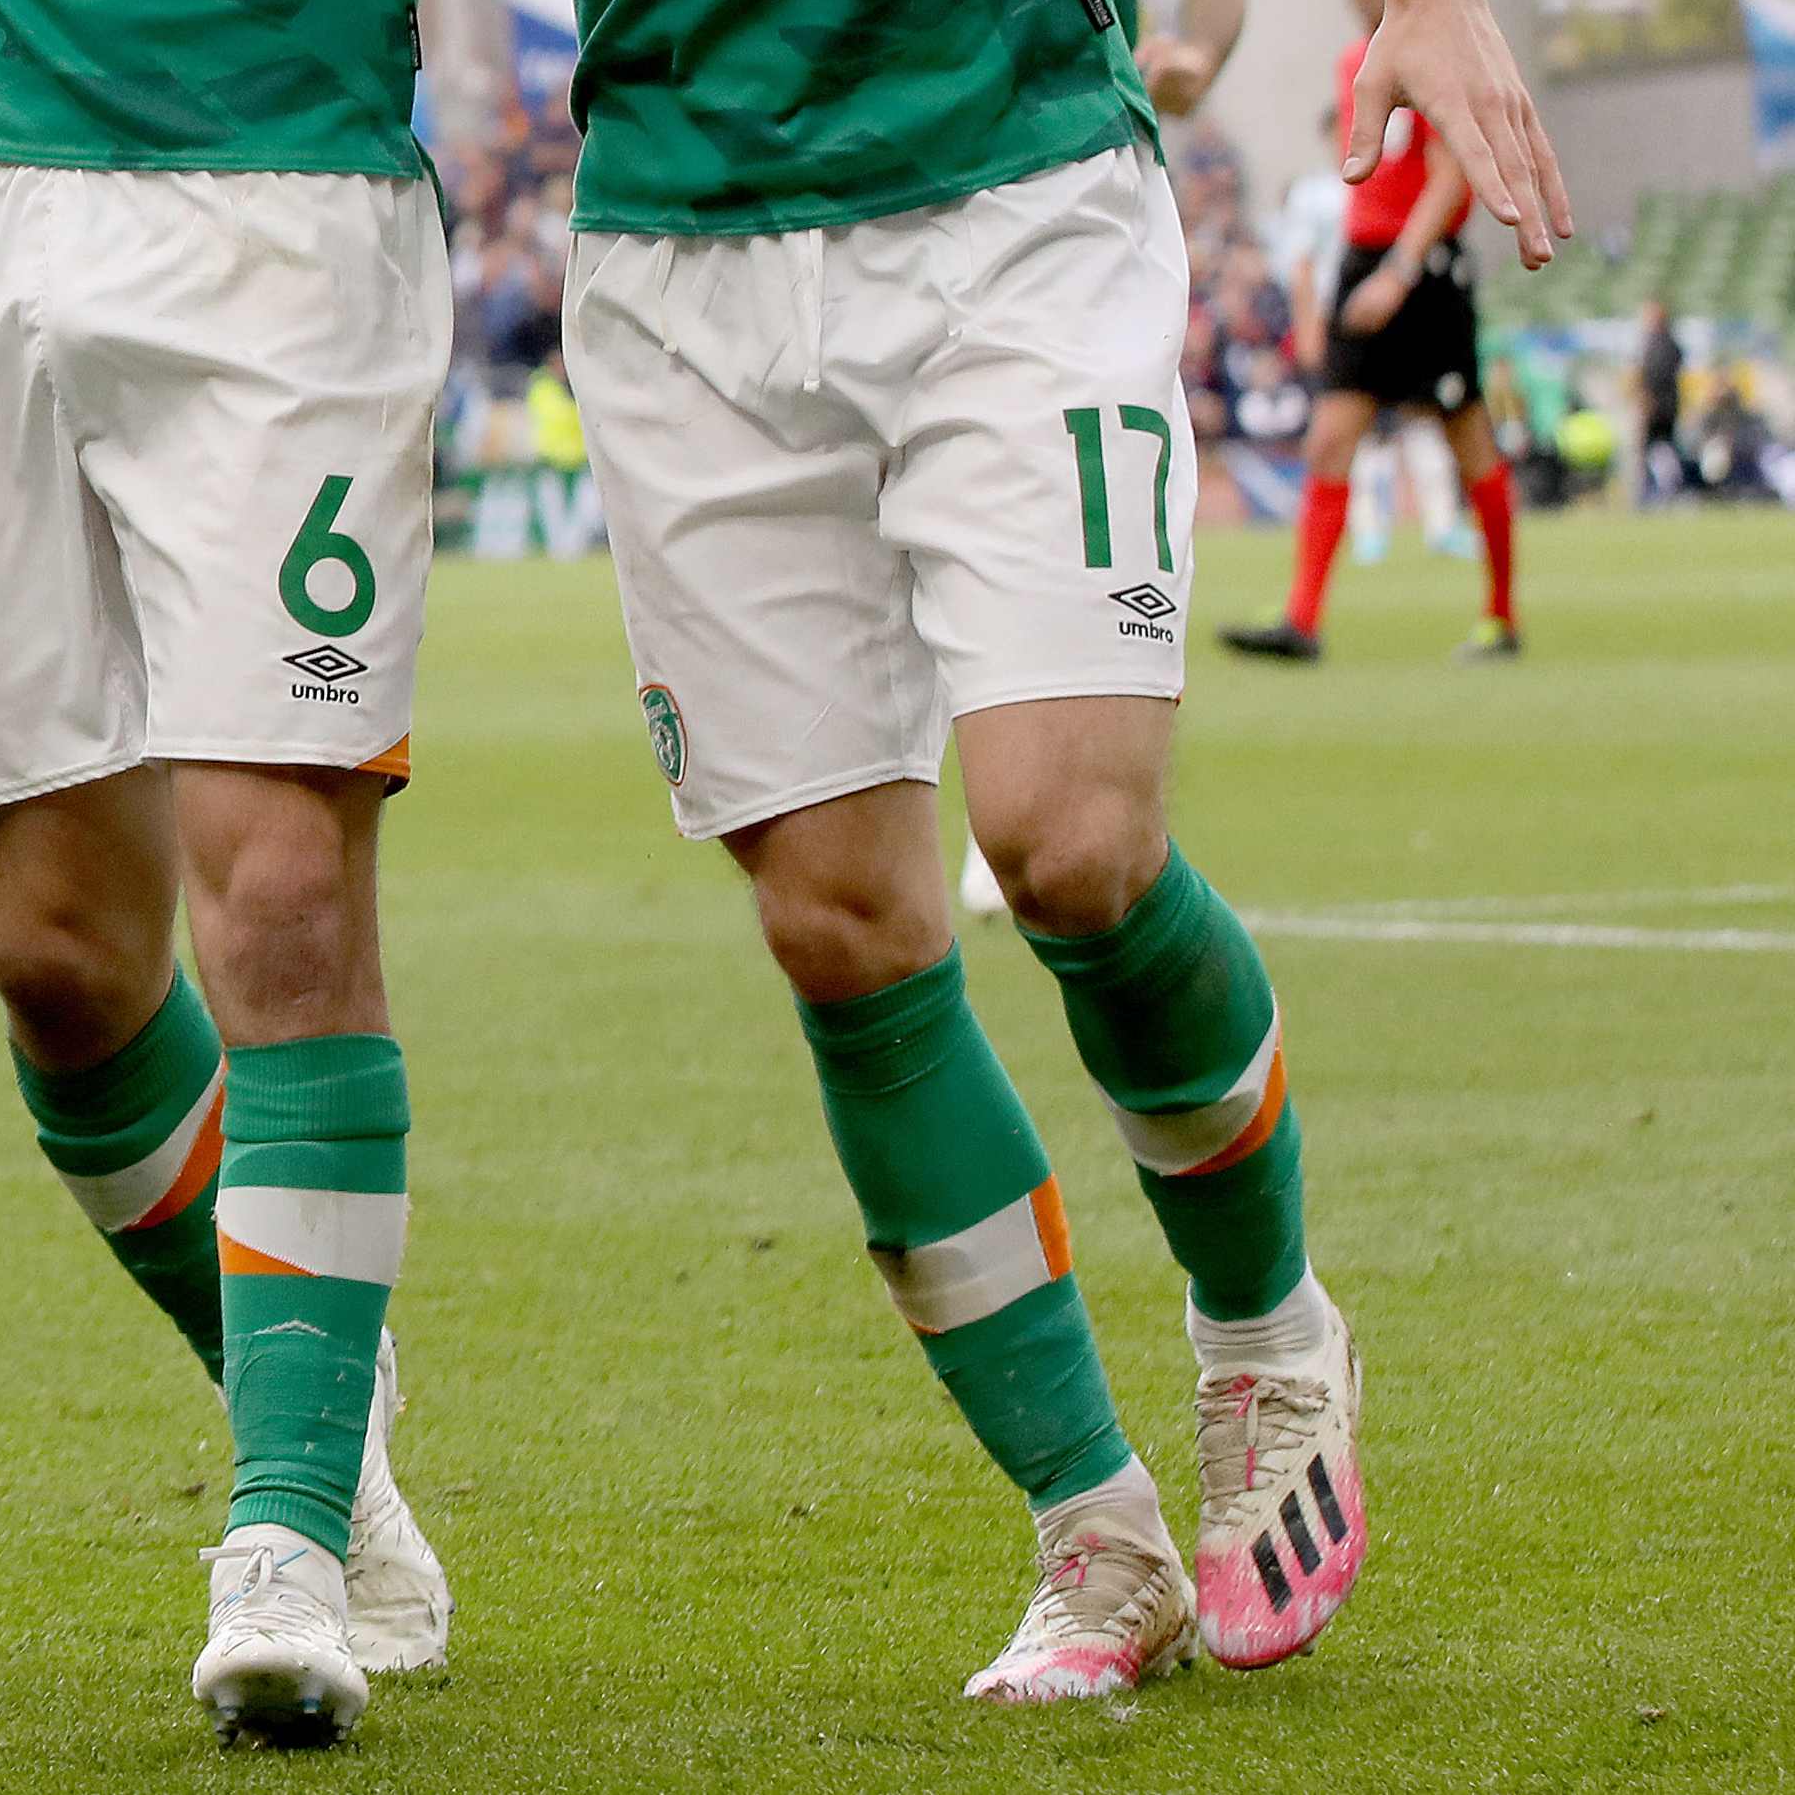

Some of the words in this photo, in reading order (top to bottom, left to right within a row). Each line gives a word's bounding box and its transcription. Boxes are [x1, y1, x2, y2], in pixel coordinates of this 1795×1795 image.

[1063, 404, 1175, 574] 17
[279, 474, 376, 637] 6
[1119, 621, 1174, 643] umbro
[292, 684, 359, 704] umbro
